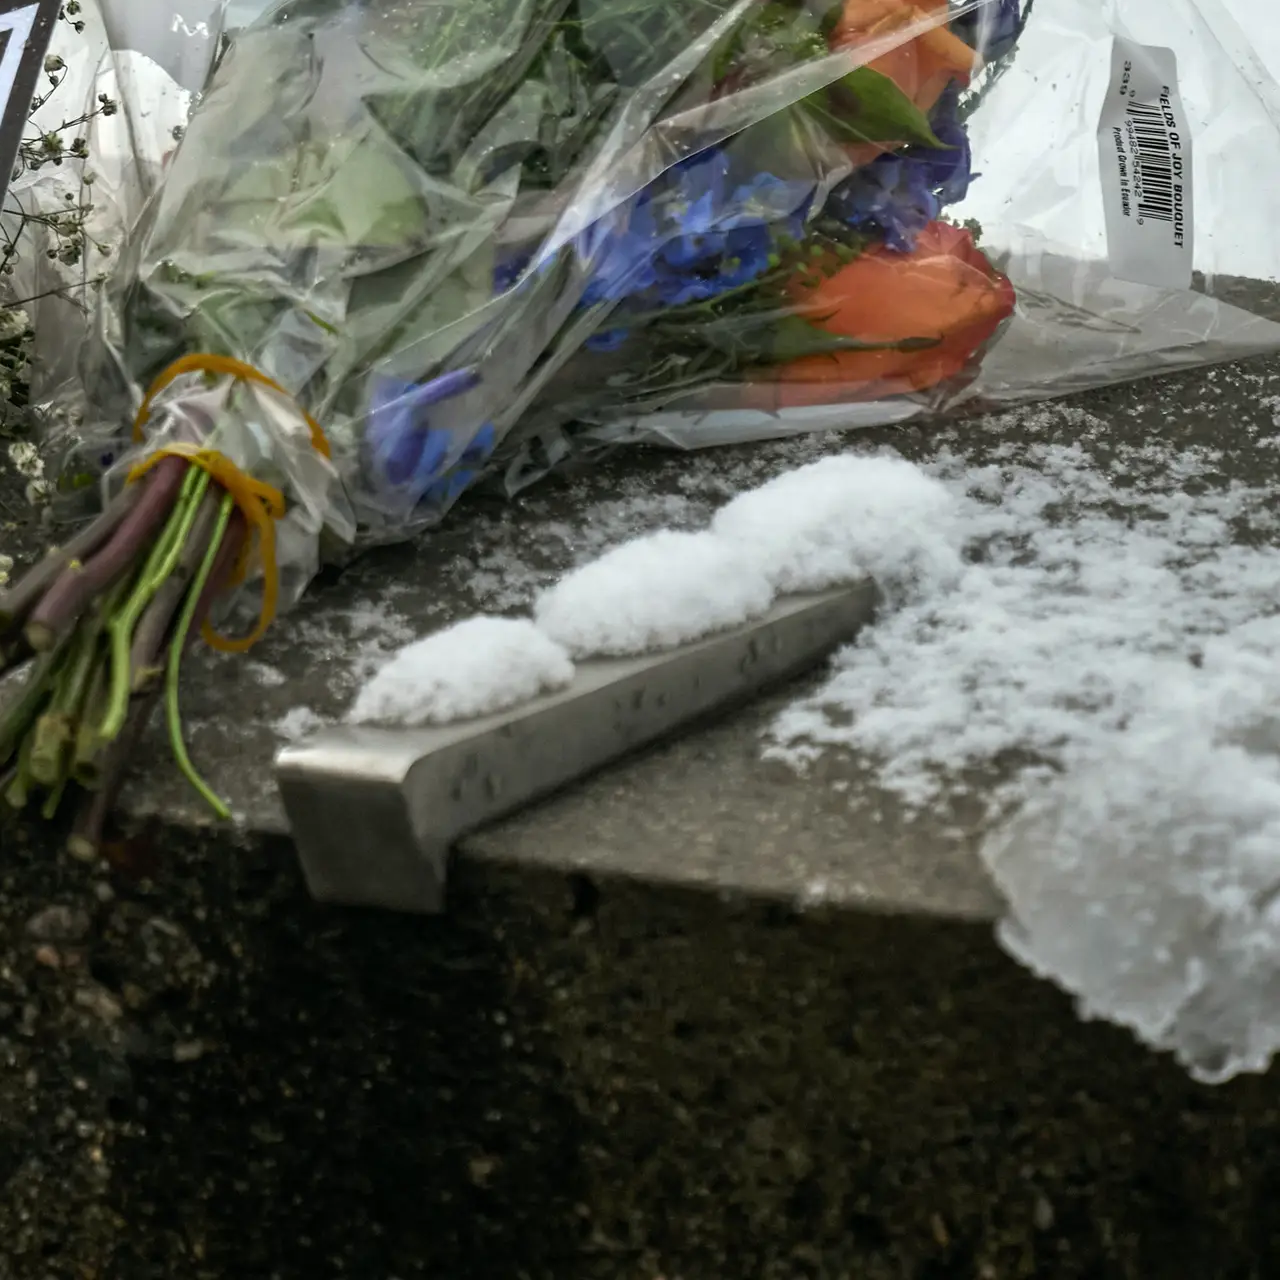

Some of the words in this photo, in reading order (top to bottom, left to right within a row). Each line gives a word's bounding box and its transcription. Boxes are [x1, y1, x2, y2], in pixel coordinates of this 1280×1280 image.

[1159, 85, 1176, 129] FIELDS
[1113, 126, 1125, 153] Product
[1169, 132, 1181, 150] OF
[1118, 155, 1128, 177] Grown
[1172, 153, 1183, 180] JOY
[1173, 184, 1184, 249] BOUQUET
